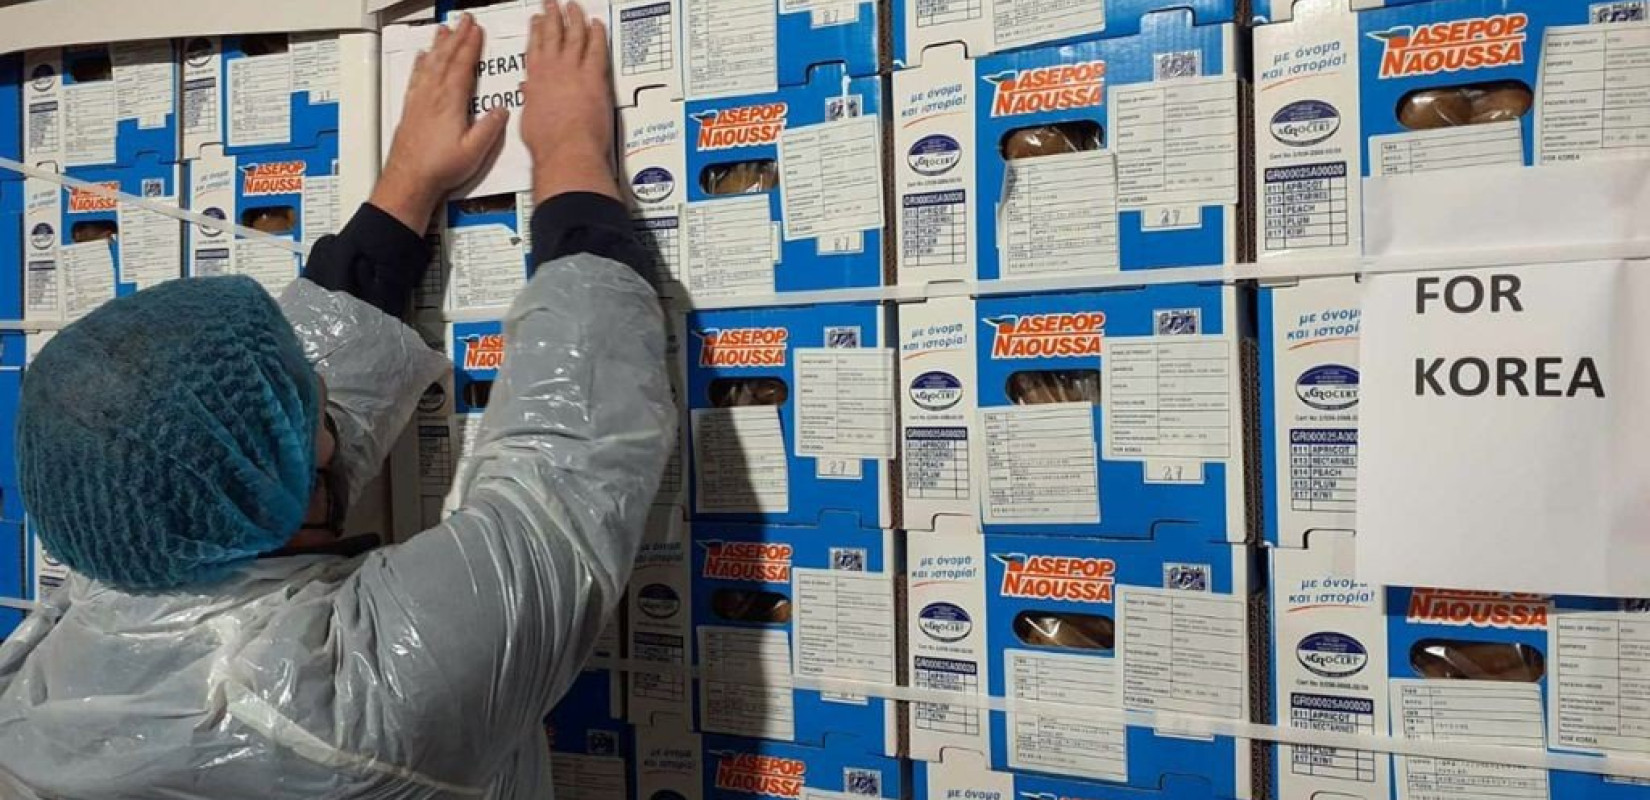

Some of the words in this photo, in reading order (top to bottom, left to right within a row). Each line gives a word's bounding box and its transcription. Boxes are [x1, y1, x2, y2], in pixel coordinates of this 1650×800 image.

[1411, 16, 1525, 45] ASEPOP
[1274, 52, 1289, 65] με
[1295, 41, 1340, 58] όνομα
[1381, 43, 1524, 75] NAOUSSA
[477, 53, 528, 77] PERAT
[1262, 67, 1283, 80] και
[1289, 52, 1347, 74] ιστορία!
[1018, 62, 1105, 90] ASEPOP
[928, 84, 962, 98] όνομα
[995, 84, 1102, 114] NAOUSSA
[471, 90, 525, 115] ECORD
[718, 103, 785, 124] ASEPOP
[256, 161, 304, 175] ASEPOP
[245, 177, 302, 194] NAOUSSA
[1286, 204, 1316, 214] PEACH
[1286, 215, 1310, 226] PLUM
[1415, 273, 1524, 314] FOR
[1018, 313, 1105, 336] ASEPOP
[1299, 314, 1316, 326] με
[1322, 309, 1361, 322] όνομ
[719, 329, 786, 345] ASEPOP
[927, 323, 963, 335] όνομα
[1287, 329, 1309, 340] και
[1315, 321, 1360, 336] ιστορί
[994, 336, 1101, 356] NAOUSSA
[701, 348, 785, 365] NAOUSSA
[1414, 356, 1606, 398] KOREA
[1312, 446, 1350, 455] APRICOT
[1312, 468, 1341, 477] PEACH
[1312, 480, 1337, 488] PLUM
[722, 543, 791, 560] ASEPOP
[937, 555, 972, 566] όνομα
[705, 558, 787, 581] NAOUSSA
[1025, 556, 1113, 578] ASEPOP
[1003, 577, 1112, 600] NAOUSSA
[1302, 579, 1317, 590] με
[1288, 594, 1310, 603] και
[1316, 590, 1374, 604] ιστορία!
[1409, 594, 1547, 625] NAOUSSA
[733, 753, 806, 775] ASEPOP
